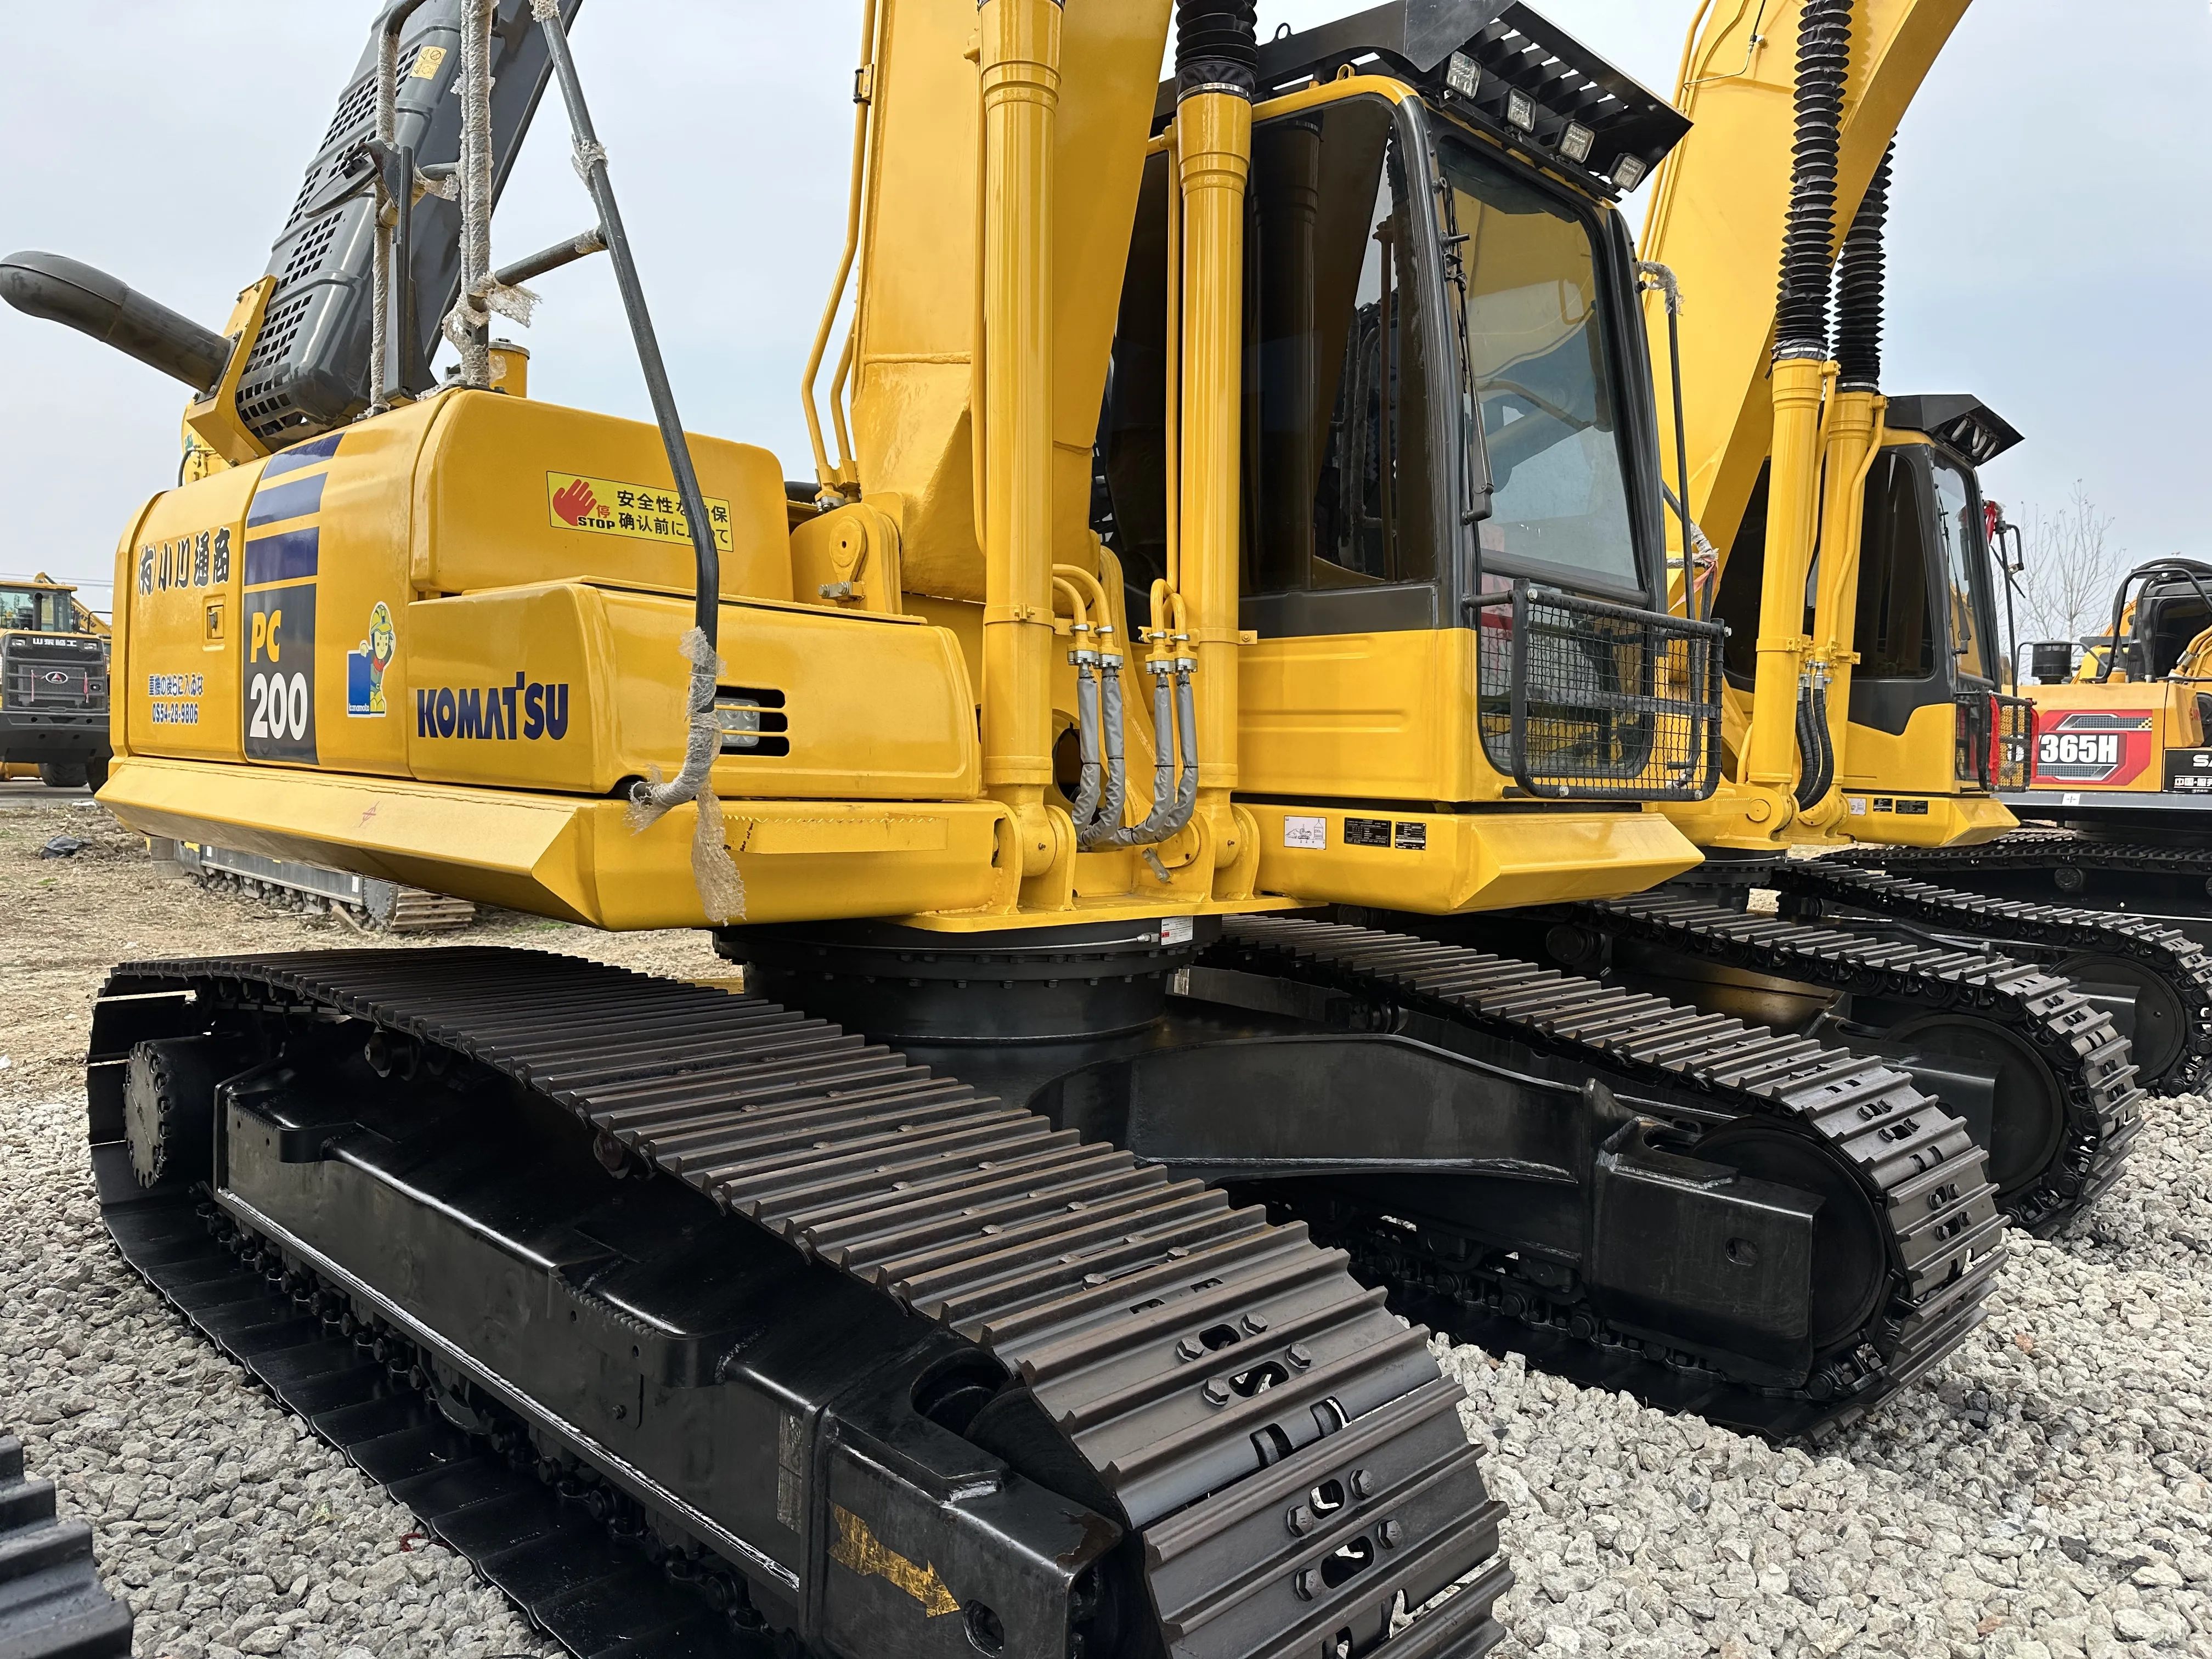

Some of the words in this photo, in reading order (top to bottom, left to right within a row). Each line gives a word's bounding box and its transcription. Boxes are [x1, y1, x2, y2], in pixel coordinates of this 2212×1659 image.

[578, 516, 616, 529] STOP
[596, 505, 611, 518] 停
[250, 610, 281, 663] PC
[249, 672, 308, 741] 200
[417, 671, 568, 740] KOMATSU
[2039, 734, 2118, 763] 365H
